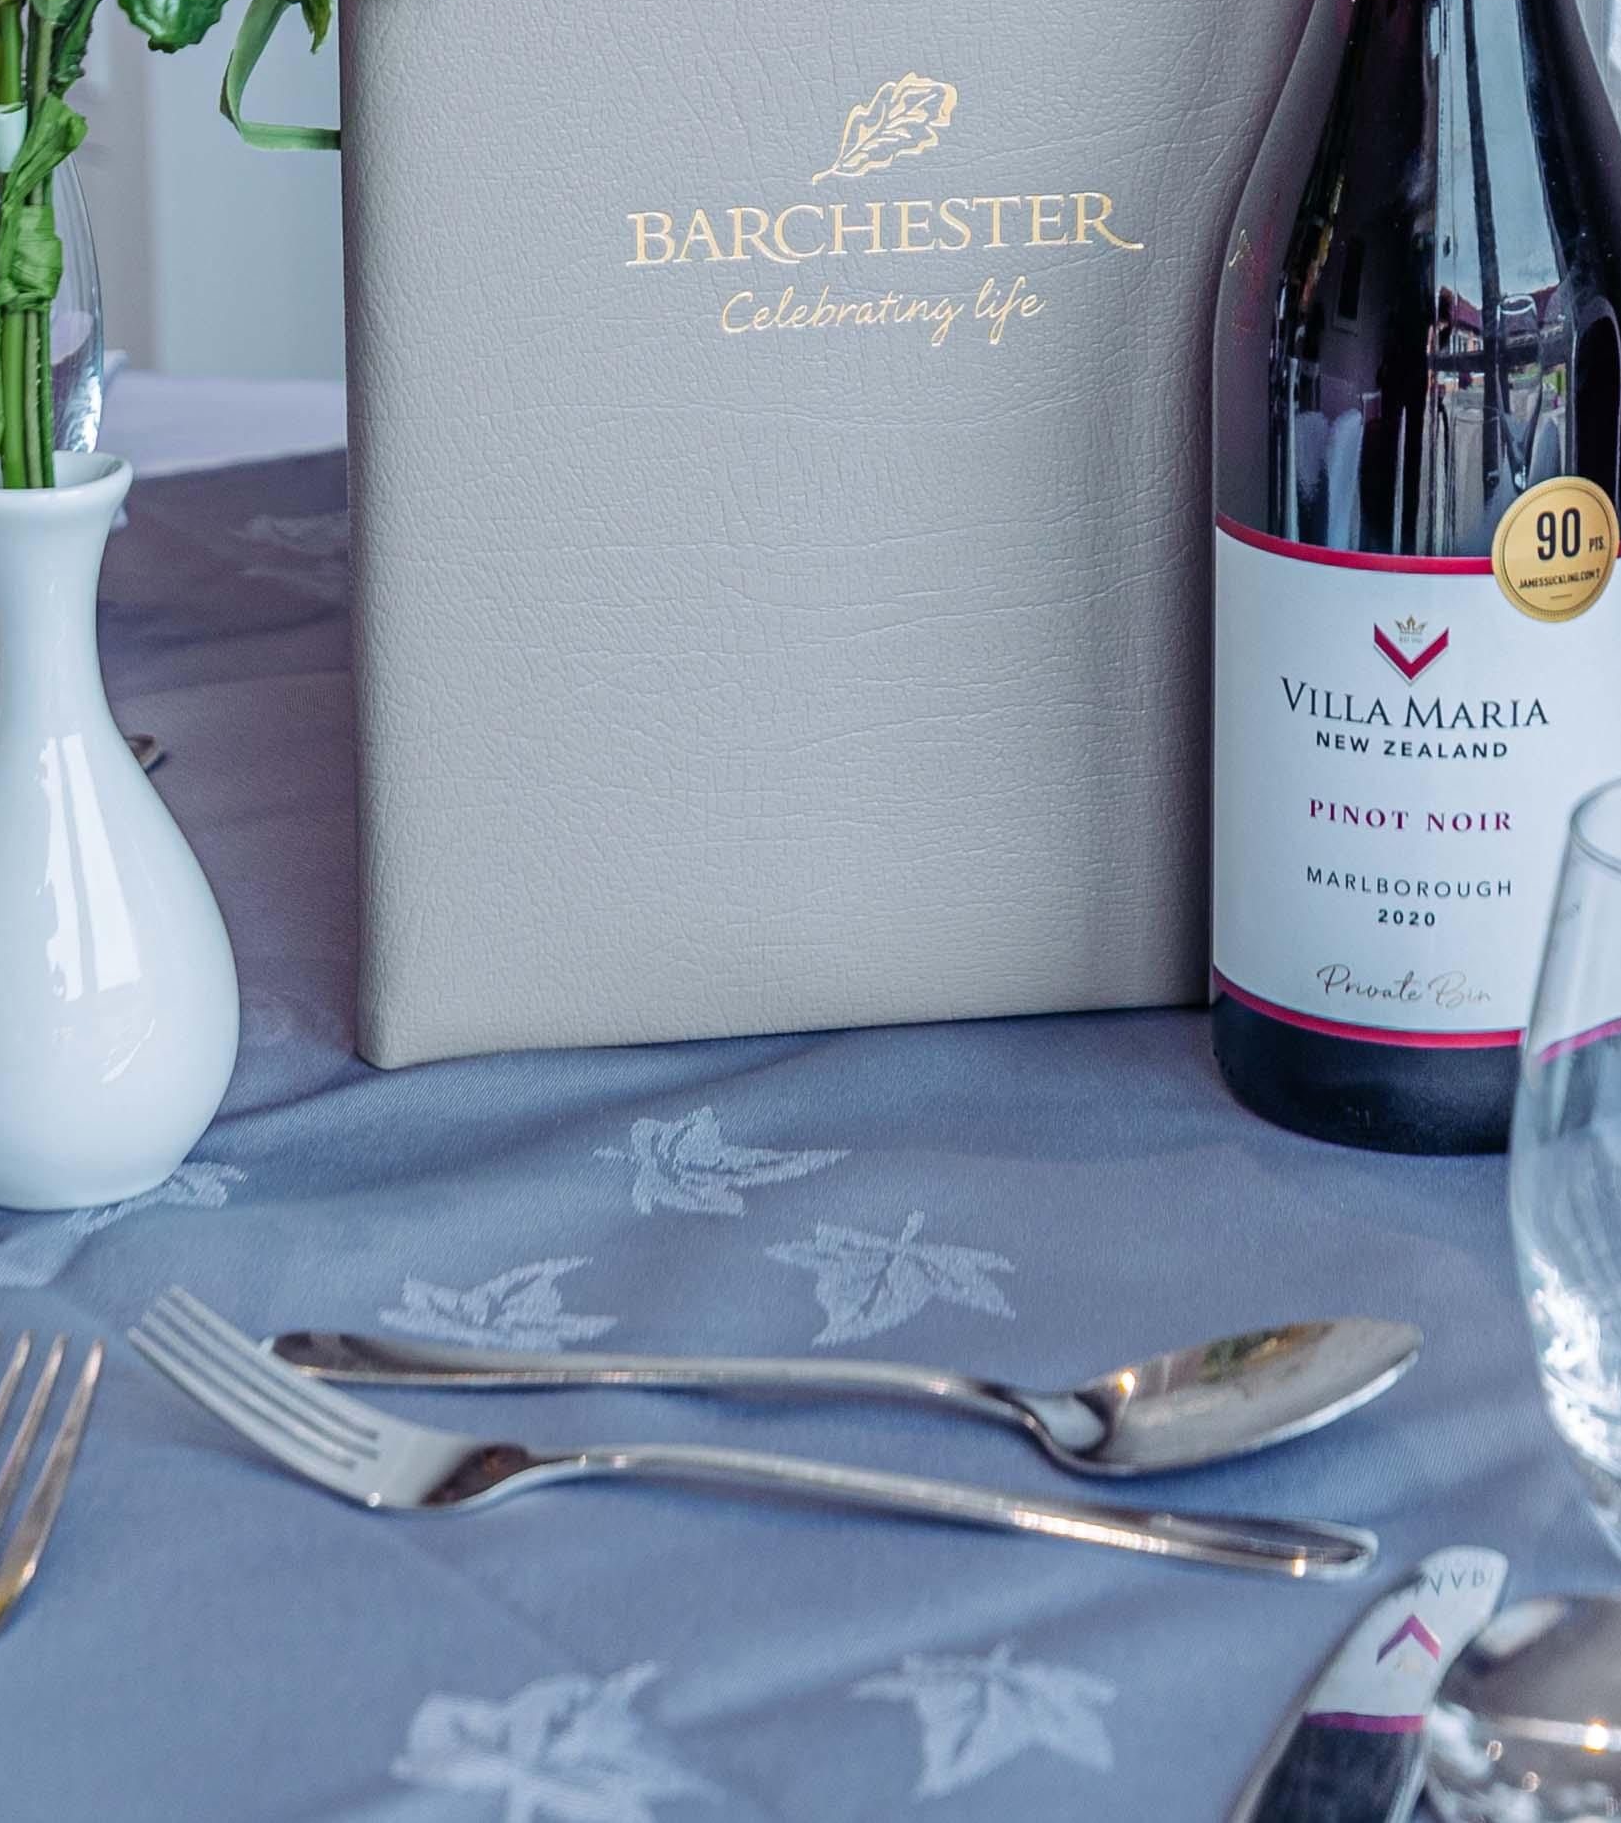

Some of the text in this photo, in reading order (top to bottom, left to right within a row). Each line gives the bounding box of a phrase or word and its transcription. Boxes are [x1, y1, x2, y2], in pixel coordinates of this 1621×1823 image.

[626, 191, 1145, 268] BARCHESTER
[721, 276, 1049, 347] Celebrating life
[1536, 507, 1582, 562] 90
[1280, 676, 1550, 729] VILLA MARIA
[1315, 730, 1508, 759] NEW ZEALAND
[1308, 797, 1513, 833] PINOT NOIR
[1306, 865, 1512, 898] MARLBOROUGH
[1377, 908, 1436, 927] 2020
[1316, 963, 1422, 1002] Private
